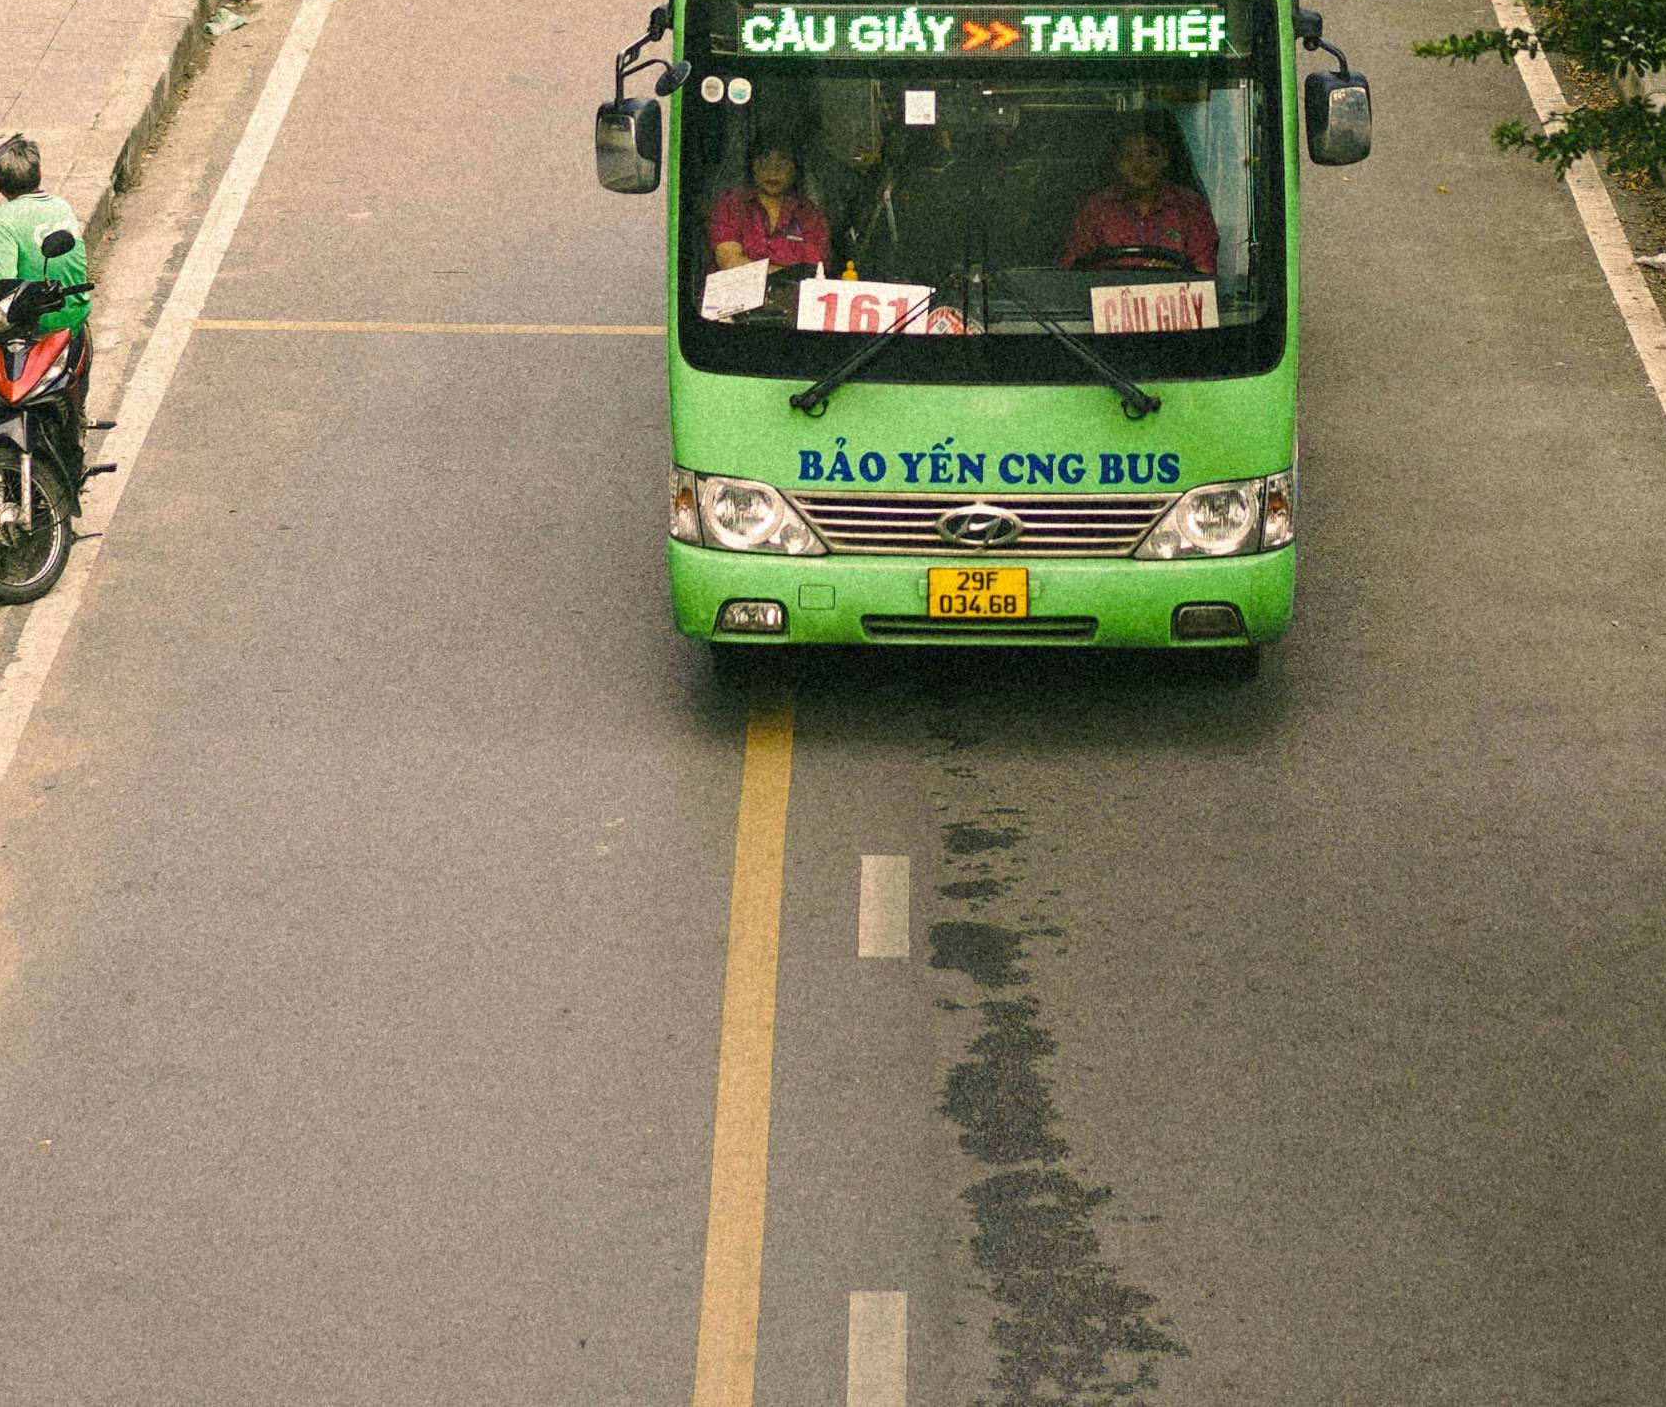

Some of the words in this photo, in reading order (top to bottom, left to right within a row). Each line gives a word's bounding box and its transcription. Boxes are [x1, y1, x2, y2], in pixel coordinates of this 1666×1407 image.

[1021, 15, 1119, 52] TAM
[817, 292, 910, 333] 161
[798, 436, 887, 483] BẢO
[898, 436, 987, 484] YẾN
[998, 453, 1086, 484] CNG
[1099, 452, 1181, 484] BUS
[957, 571, 999, 591] 29F
[939, 595, 1018, 614] 034.68
